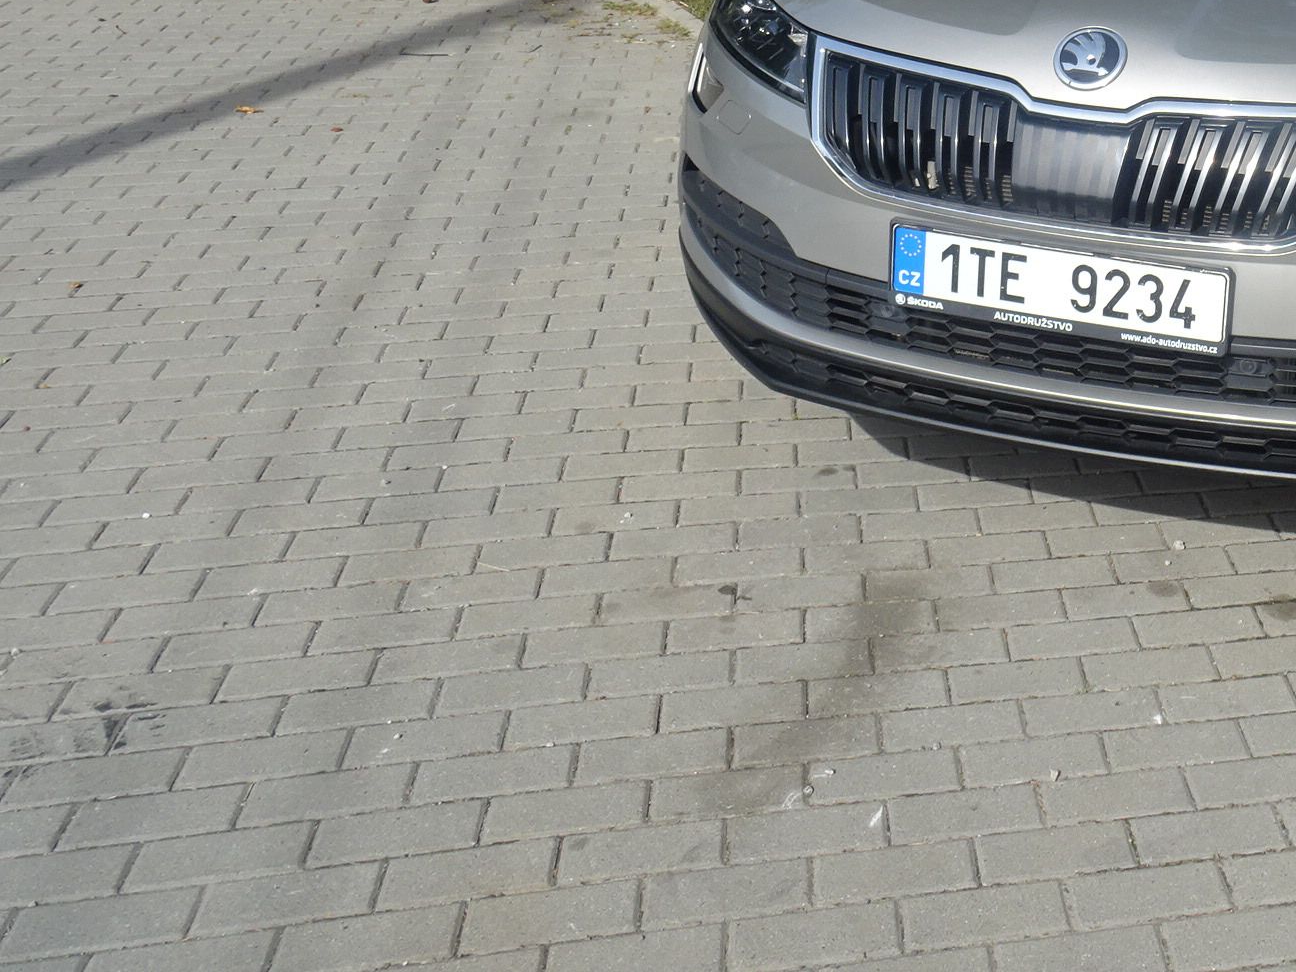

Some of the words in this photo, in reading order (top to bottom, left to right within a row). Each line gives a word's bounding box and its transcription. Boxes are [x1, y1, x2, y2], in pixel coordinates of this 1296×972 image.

[898, 269, 921, 287] CZ
[941, 243, 1028, 305] 1TE
[1070, 264, 1197, 329] 9234
[907, 296, 944, 310] ŠKODA
[993, 311, 1073, 332] AUTODRUŽSTVO
